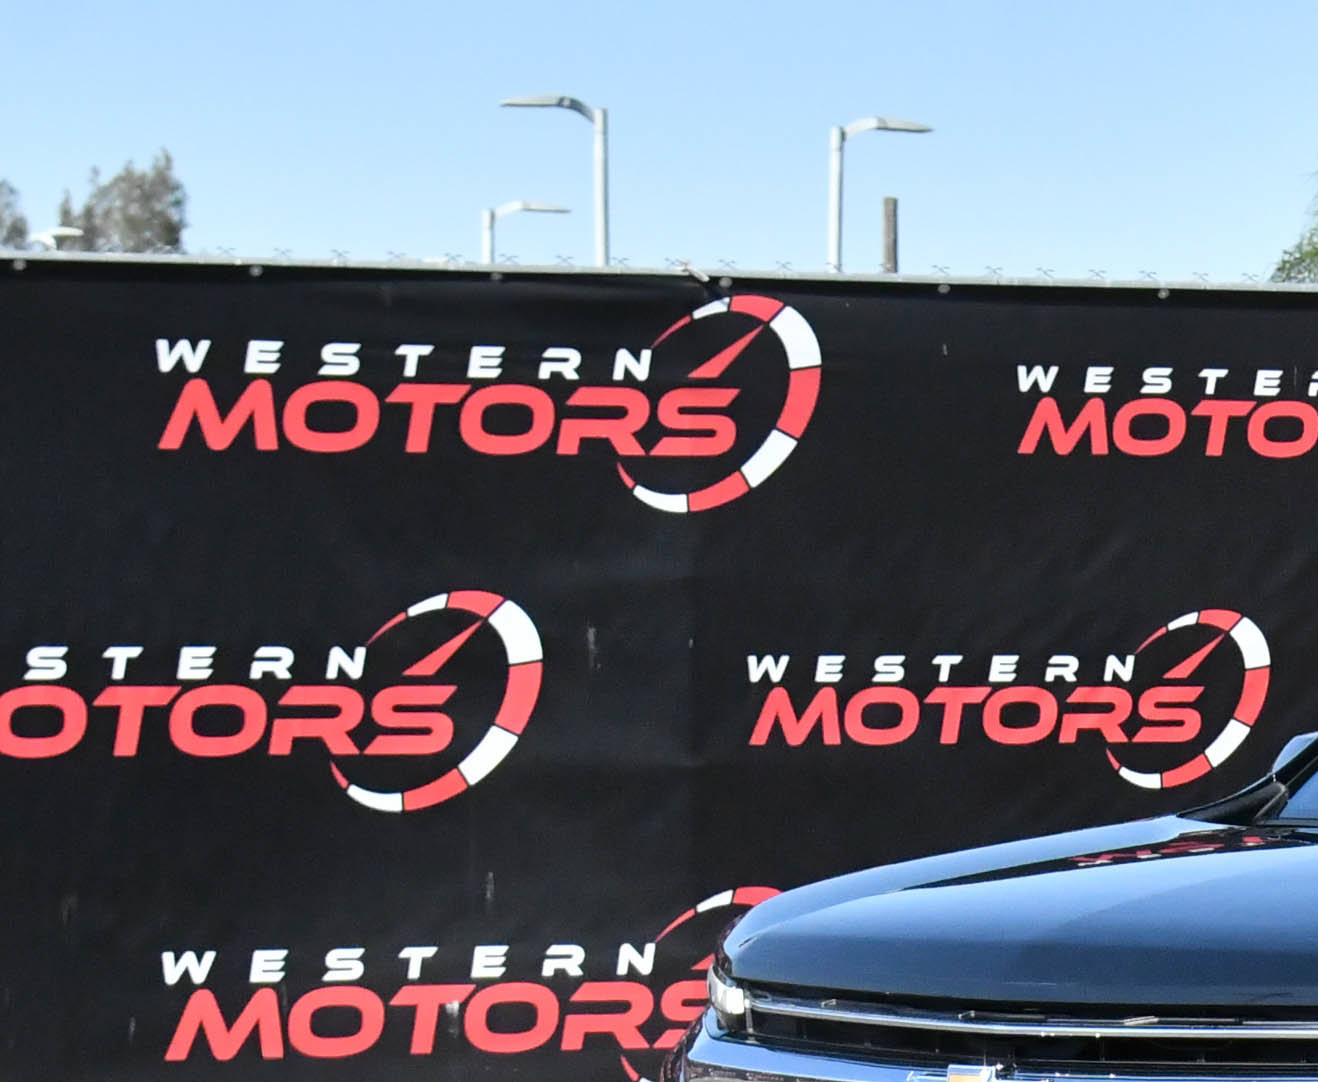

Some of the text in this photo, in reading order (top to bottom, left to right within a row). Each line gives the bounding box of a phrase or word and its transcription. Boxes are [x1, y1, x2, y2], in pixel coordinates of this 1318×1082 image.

[155, 338, 653, 382] WESTERN
[158, 377, 741, 457] MOTORS
[747, 654, 1136, 683] WESTERN
[749, 685, 1205, 747] MOTORS
[161, 942, 656, 986] WESTERN
